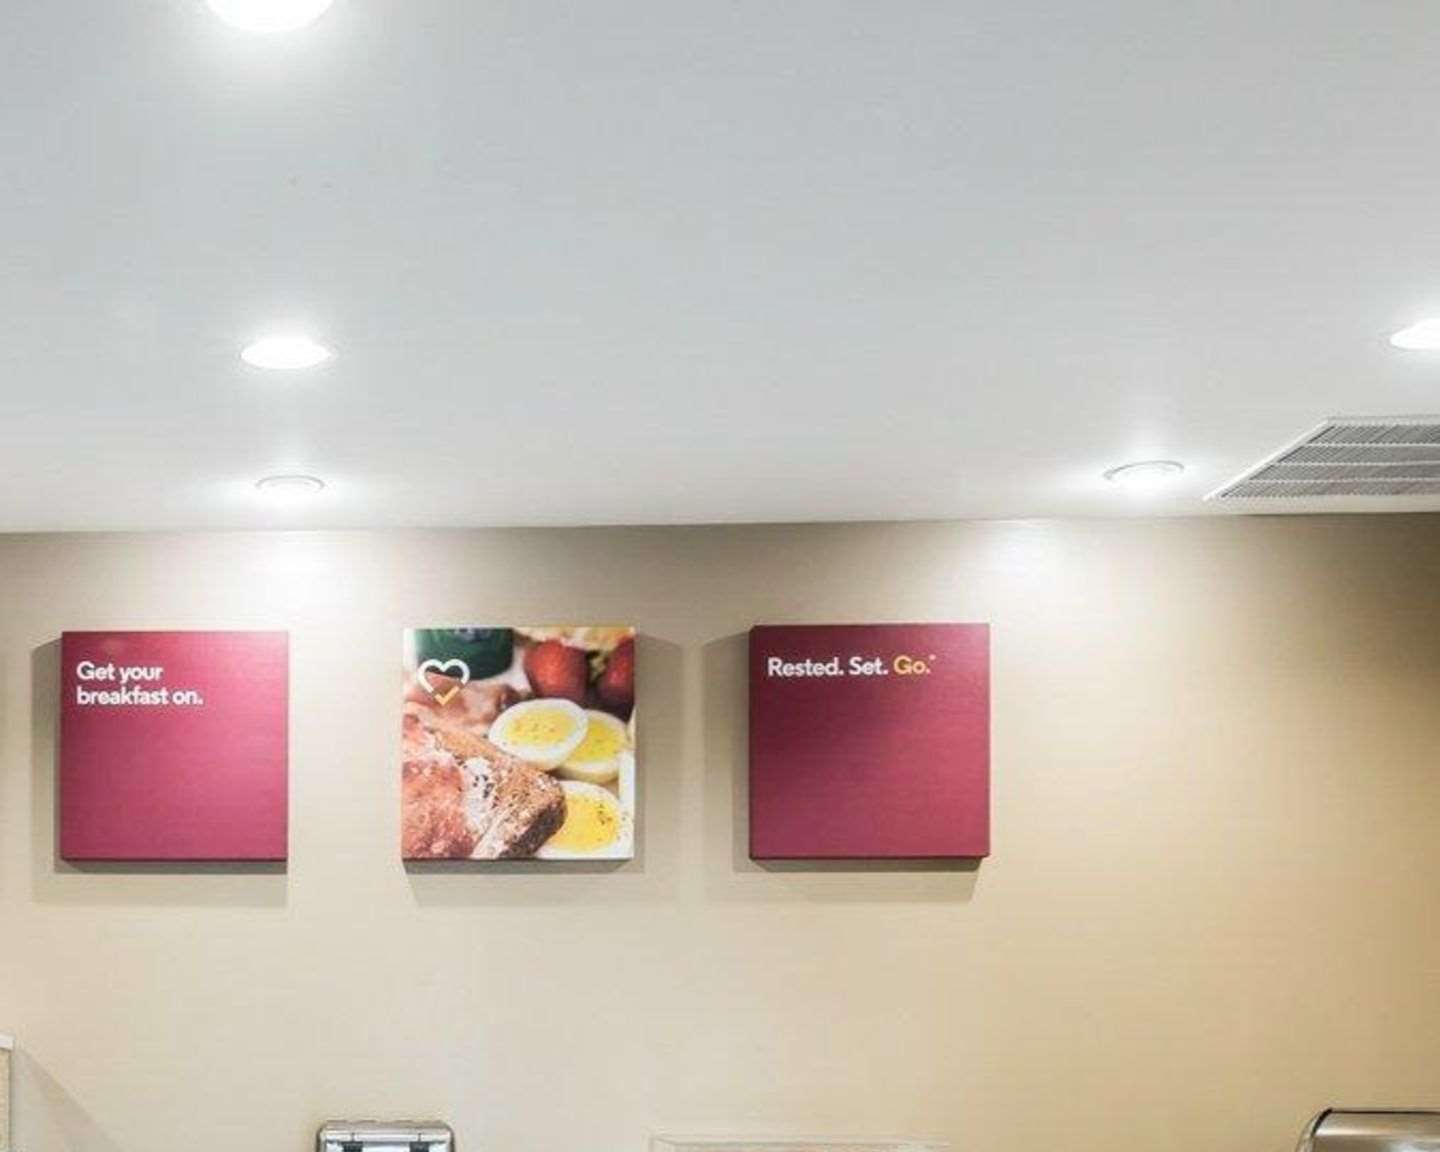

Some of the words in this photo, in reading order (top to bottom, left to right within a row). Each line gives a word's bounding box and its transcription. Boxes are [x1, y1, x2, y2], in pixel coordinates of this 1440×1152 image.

[76, 660, 115, 681] Get
[120, 664, 163, 684] your
[767, 656, 844, 676] Rested.
[848, 656, 888, 676] Set.
[76, 686, 169, 705] breakfast
[172, 690, 203, 705] on.
